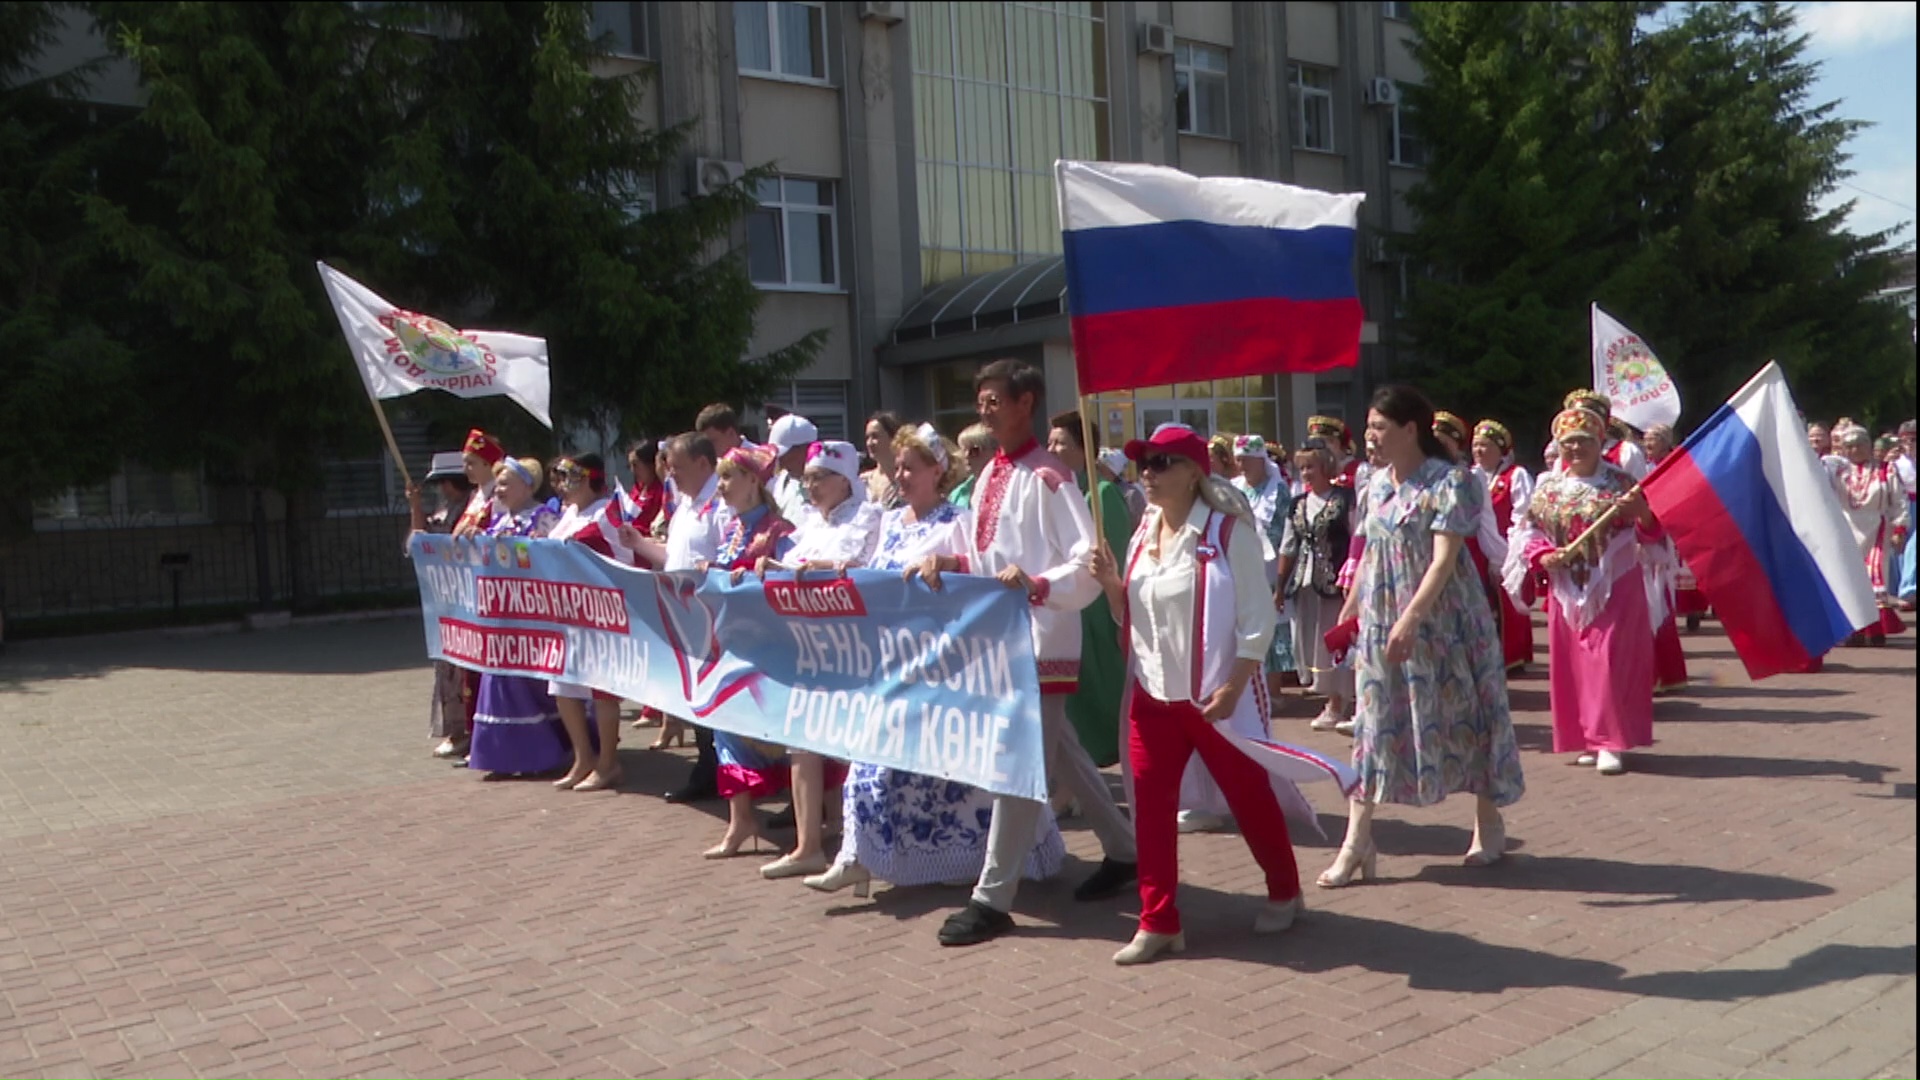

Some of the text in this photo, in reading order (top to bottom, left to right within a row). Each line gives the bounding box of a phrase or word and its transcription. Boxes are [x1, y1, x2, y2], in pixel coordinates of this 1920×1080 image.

[426, 565, 627, 628] ПАРАД ДРУЖБЫ НАРОДОВ
[773, 585, 855, 613] 12 ИЮНЯ
[567, 627, 649, 690] ПАРАДЫ
[787, 621, 1016, 701] ДЕНЬ РОССИИ
[783, 684, 909, 759] РОССИЯ
